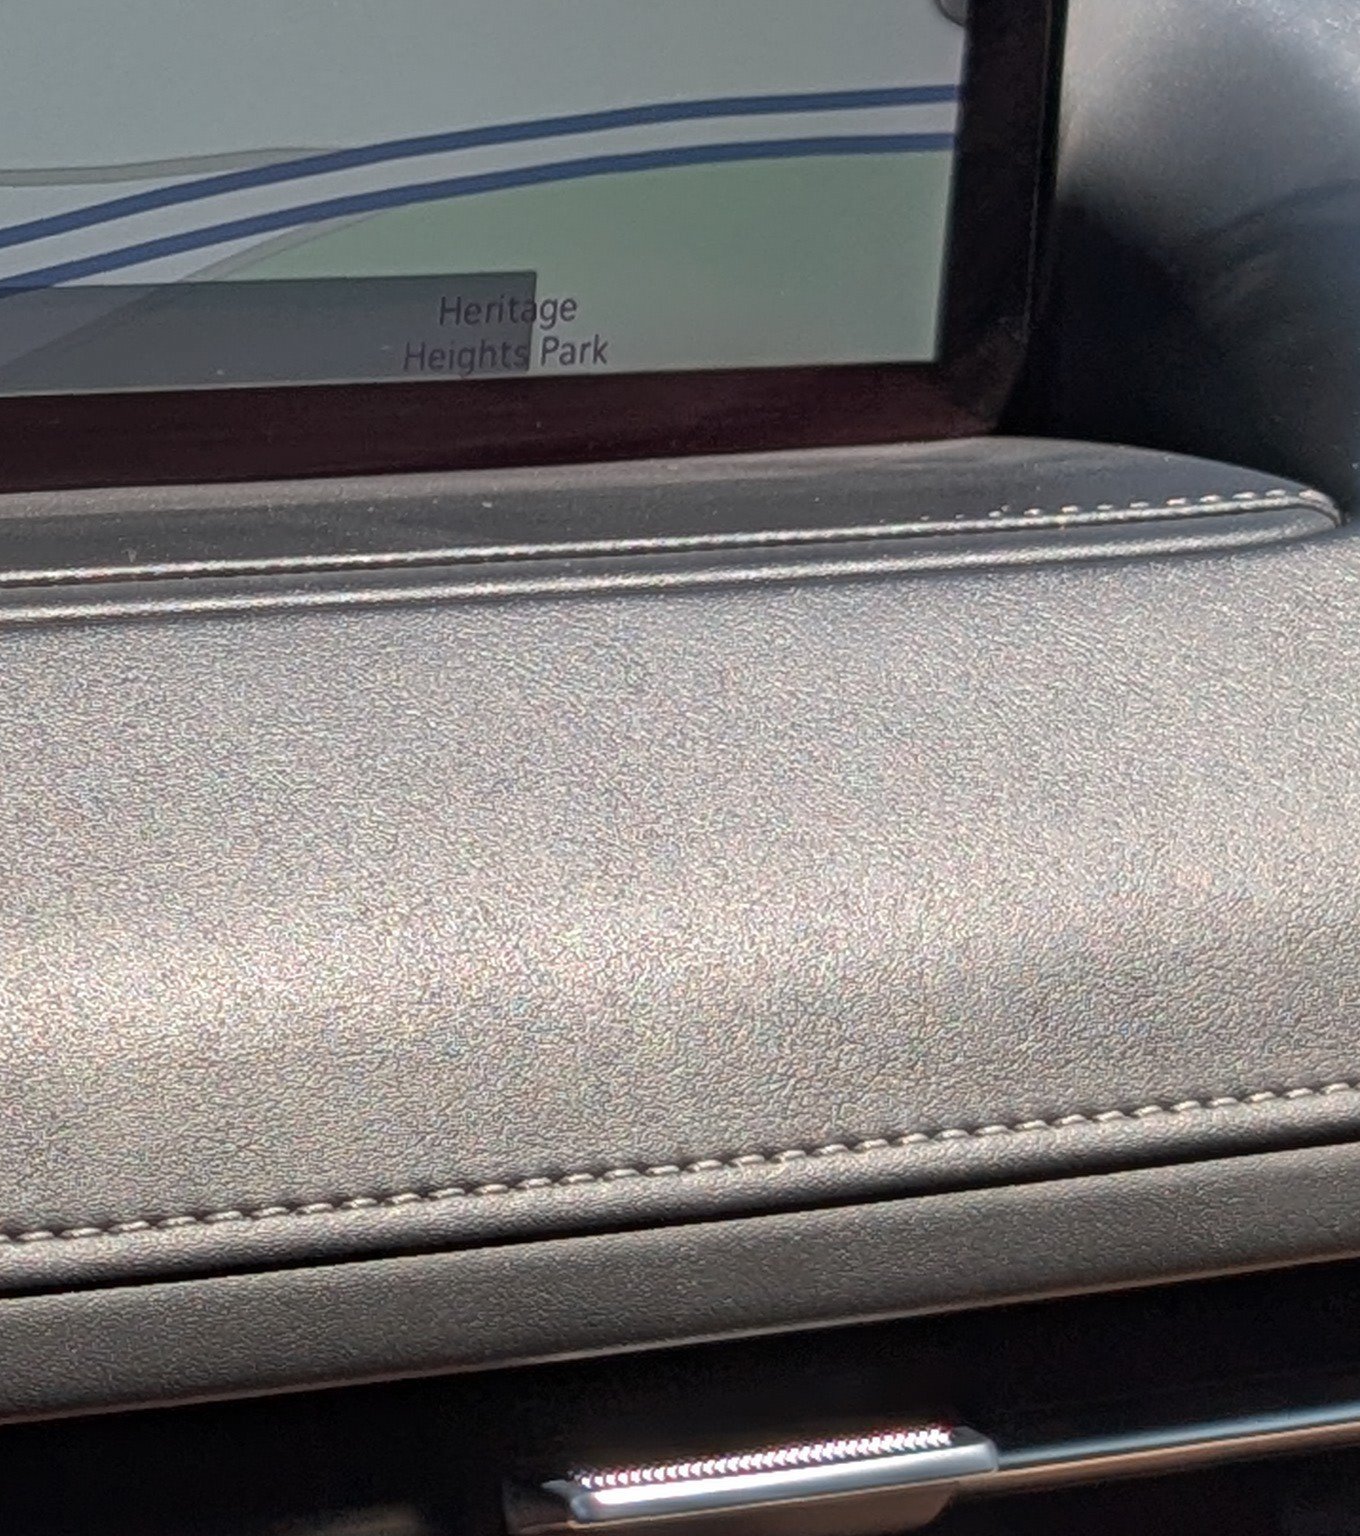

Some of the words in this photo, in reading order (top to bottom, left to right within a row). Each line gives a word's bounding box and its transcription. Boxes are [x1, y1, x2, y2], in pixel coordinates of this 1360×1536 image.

[439, 295, 578, 330] Heritage
[403, 340, 530, 376] Heights
[540, 334, 609, 366] Park
